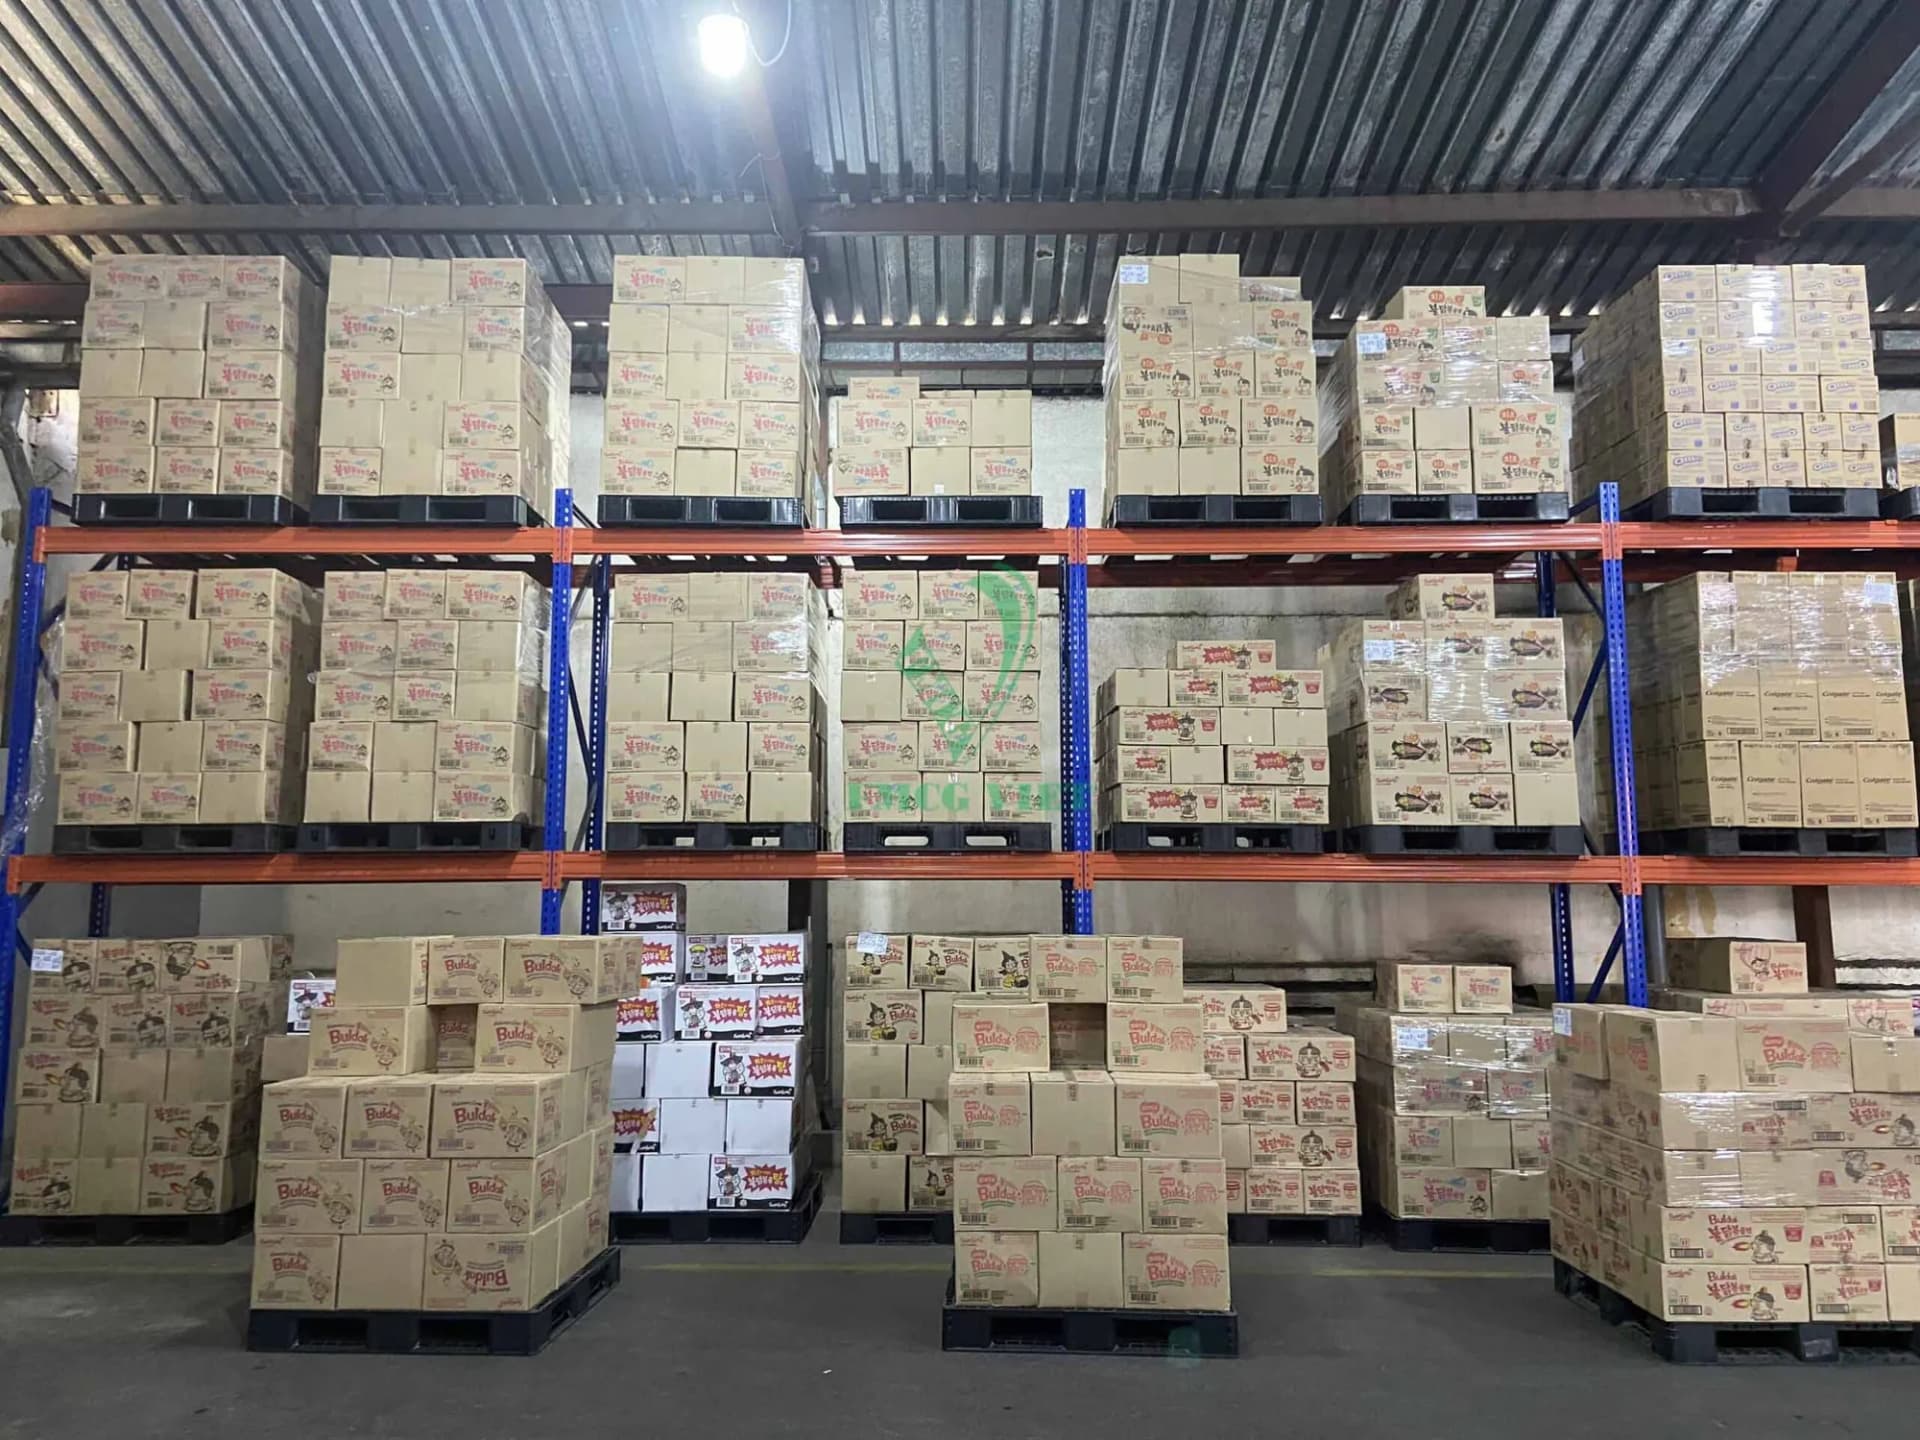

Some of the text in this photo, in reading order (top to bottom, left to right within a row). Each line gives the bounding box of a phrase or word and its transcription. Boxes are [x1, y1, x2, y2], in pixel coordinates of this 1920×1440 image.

[445, 960, 477, 971] Buldak
[524, 960, 562, 973] Buldak
[330, 1030, 368, 1043] Buldak
[497, 1028, 536, 1041] Buldak
[975, 1033, 1012, 1045] Buldak
[454, 1108, 497, 1123] Buldak
